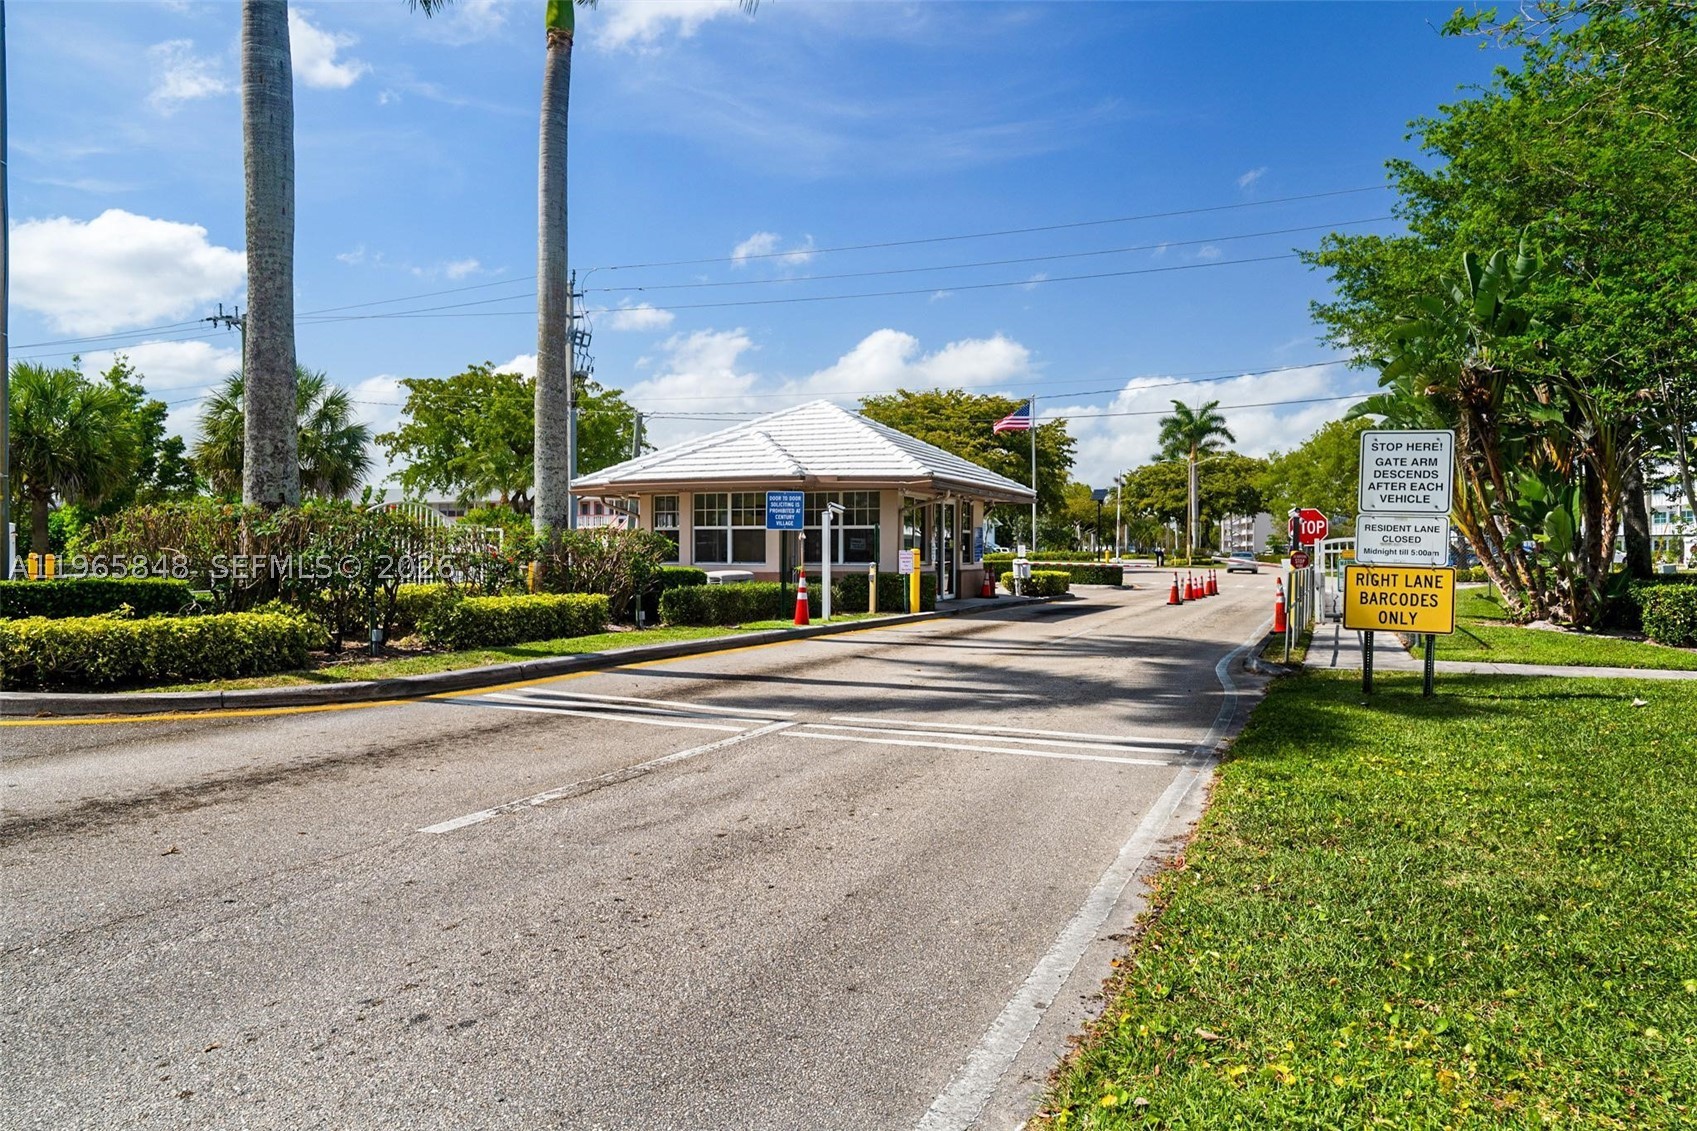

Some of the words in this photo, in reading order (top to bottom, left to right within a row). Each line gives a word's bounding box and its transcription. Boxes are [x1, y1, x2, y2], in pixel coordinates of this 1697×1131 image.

[1371, 442, 1403, 452] STOP
[1406, 442, 1443, 452] HERE!
[1375, 457, 1408, 467] GATE
[1410, 457, 1438, 467] ARM
[1373, 469, 1439, 479] DESCENDS
[1368, 482, 1407, 491] AFTER
[1410, 482, 1444, 492] EACH
[1379, 494, 1431, 504] VEHICLE
[1364, 523, 1412, 533] RESIDENT
[1414, 525, 1440, 533] LANE
[1381, 535, 1422, 544] CLOSED
[1363, 547, 1397, 556] Midnight
[1356, 573, 1399, 587] RIGHT
[1405, 574, 1444, 589] LANE
[1360, 591, 1439, 608] BARCODES
[1378, 610, 1418, 626] ONLY
